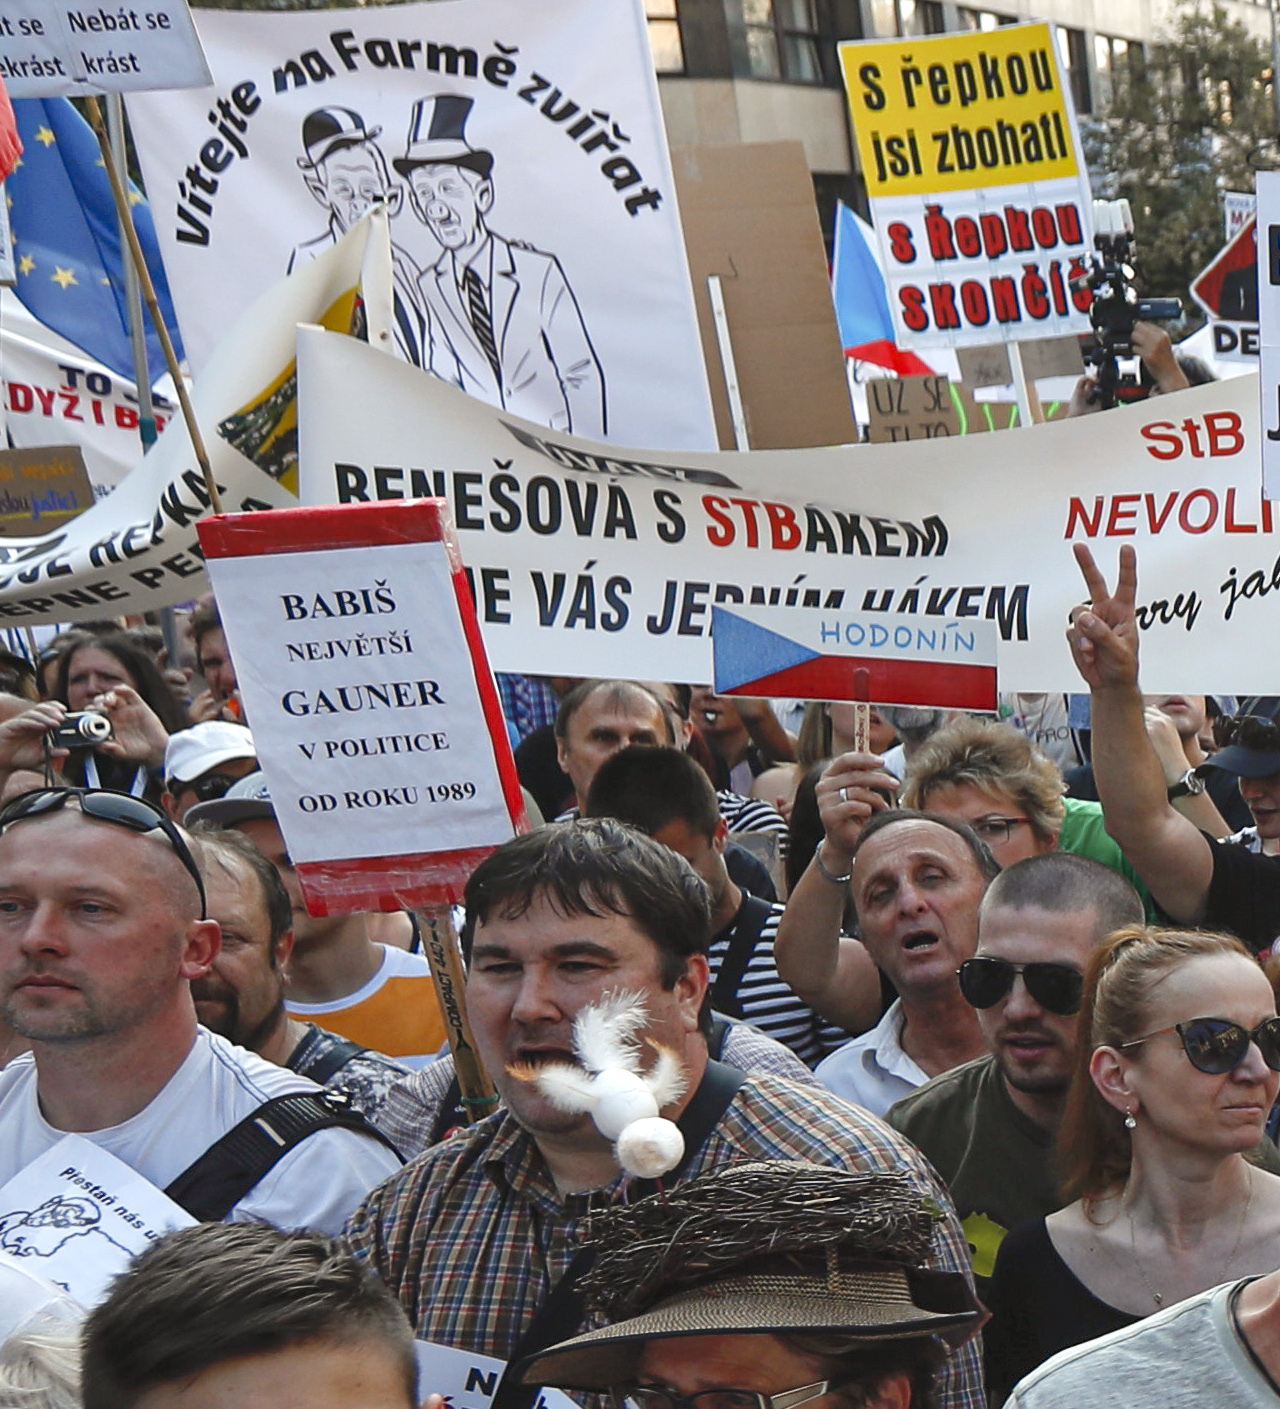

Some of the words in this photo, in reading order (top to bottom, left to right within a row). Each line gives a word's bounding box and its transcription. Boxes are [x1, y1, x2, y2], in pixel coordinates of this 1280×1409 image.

[67, 7, 141, 33] Nebát
[146, 12, 171, 30] se
[80, 51, 141, 75] krást
[900, 53, 1054, 108] řepkou
[175, 79, 262, 247] Vítejte
[272, 43, 336, 93] na
[329, 29, 520, 88] Farmě
[517, 72, 663, 217] zvířat
[932, 110, 1068, 174] zbohatl
[58, 364, 113, 396] TO
[6, 380, 84, 422] DYŽ
[1141, 411, 1244, 461] StB
[656, 488, 686, 543] S
[281, 579, 397, 621] BABIŠ
[529, 560, 633, 633] VÁS
[286, 629, 414, 662] NEJVĚTŠÍ
[819, 620, 976, 655] HODONÍN
[281, 680, 447, 717] GAUNER
[298, 743, 317, 761] V
[324, 731, 451, 760] POLITICE
[298, 794, 338, 814] OD
[343, 785, 420, 810] ROKU
[426, 781, 477, 803] 1989
[114, 1204, 147, 1231] nás
